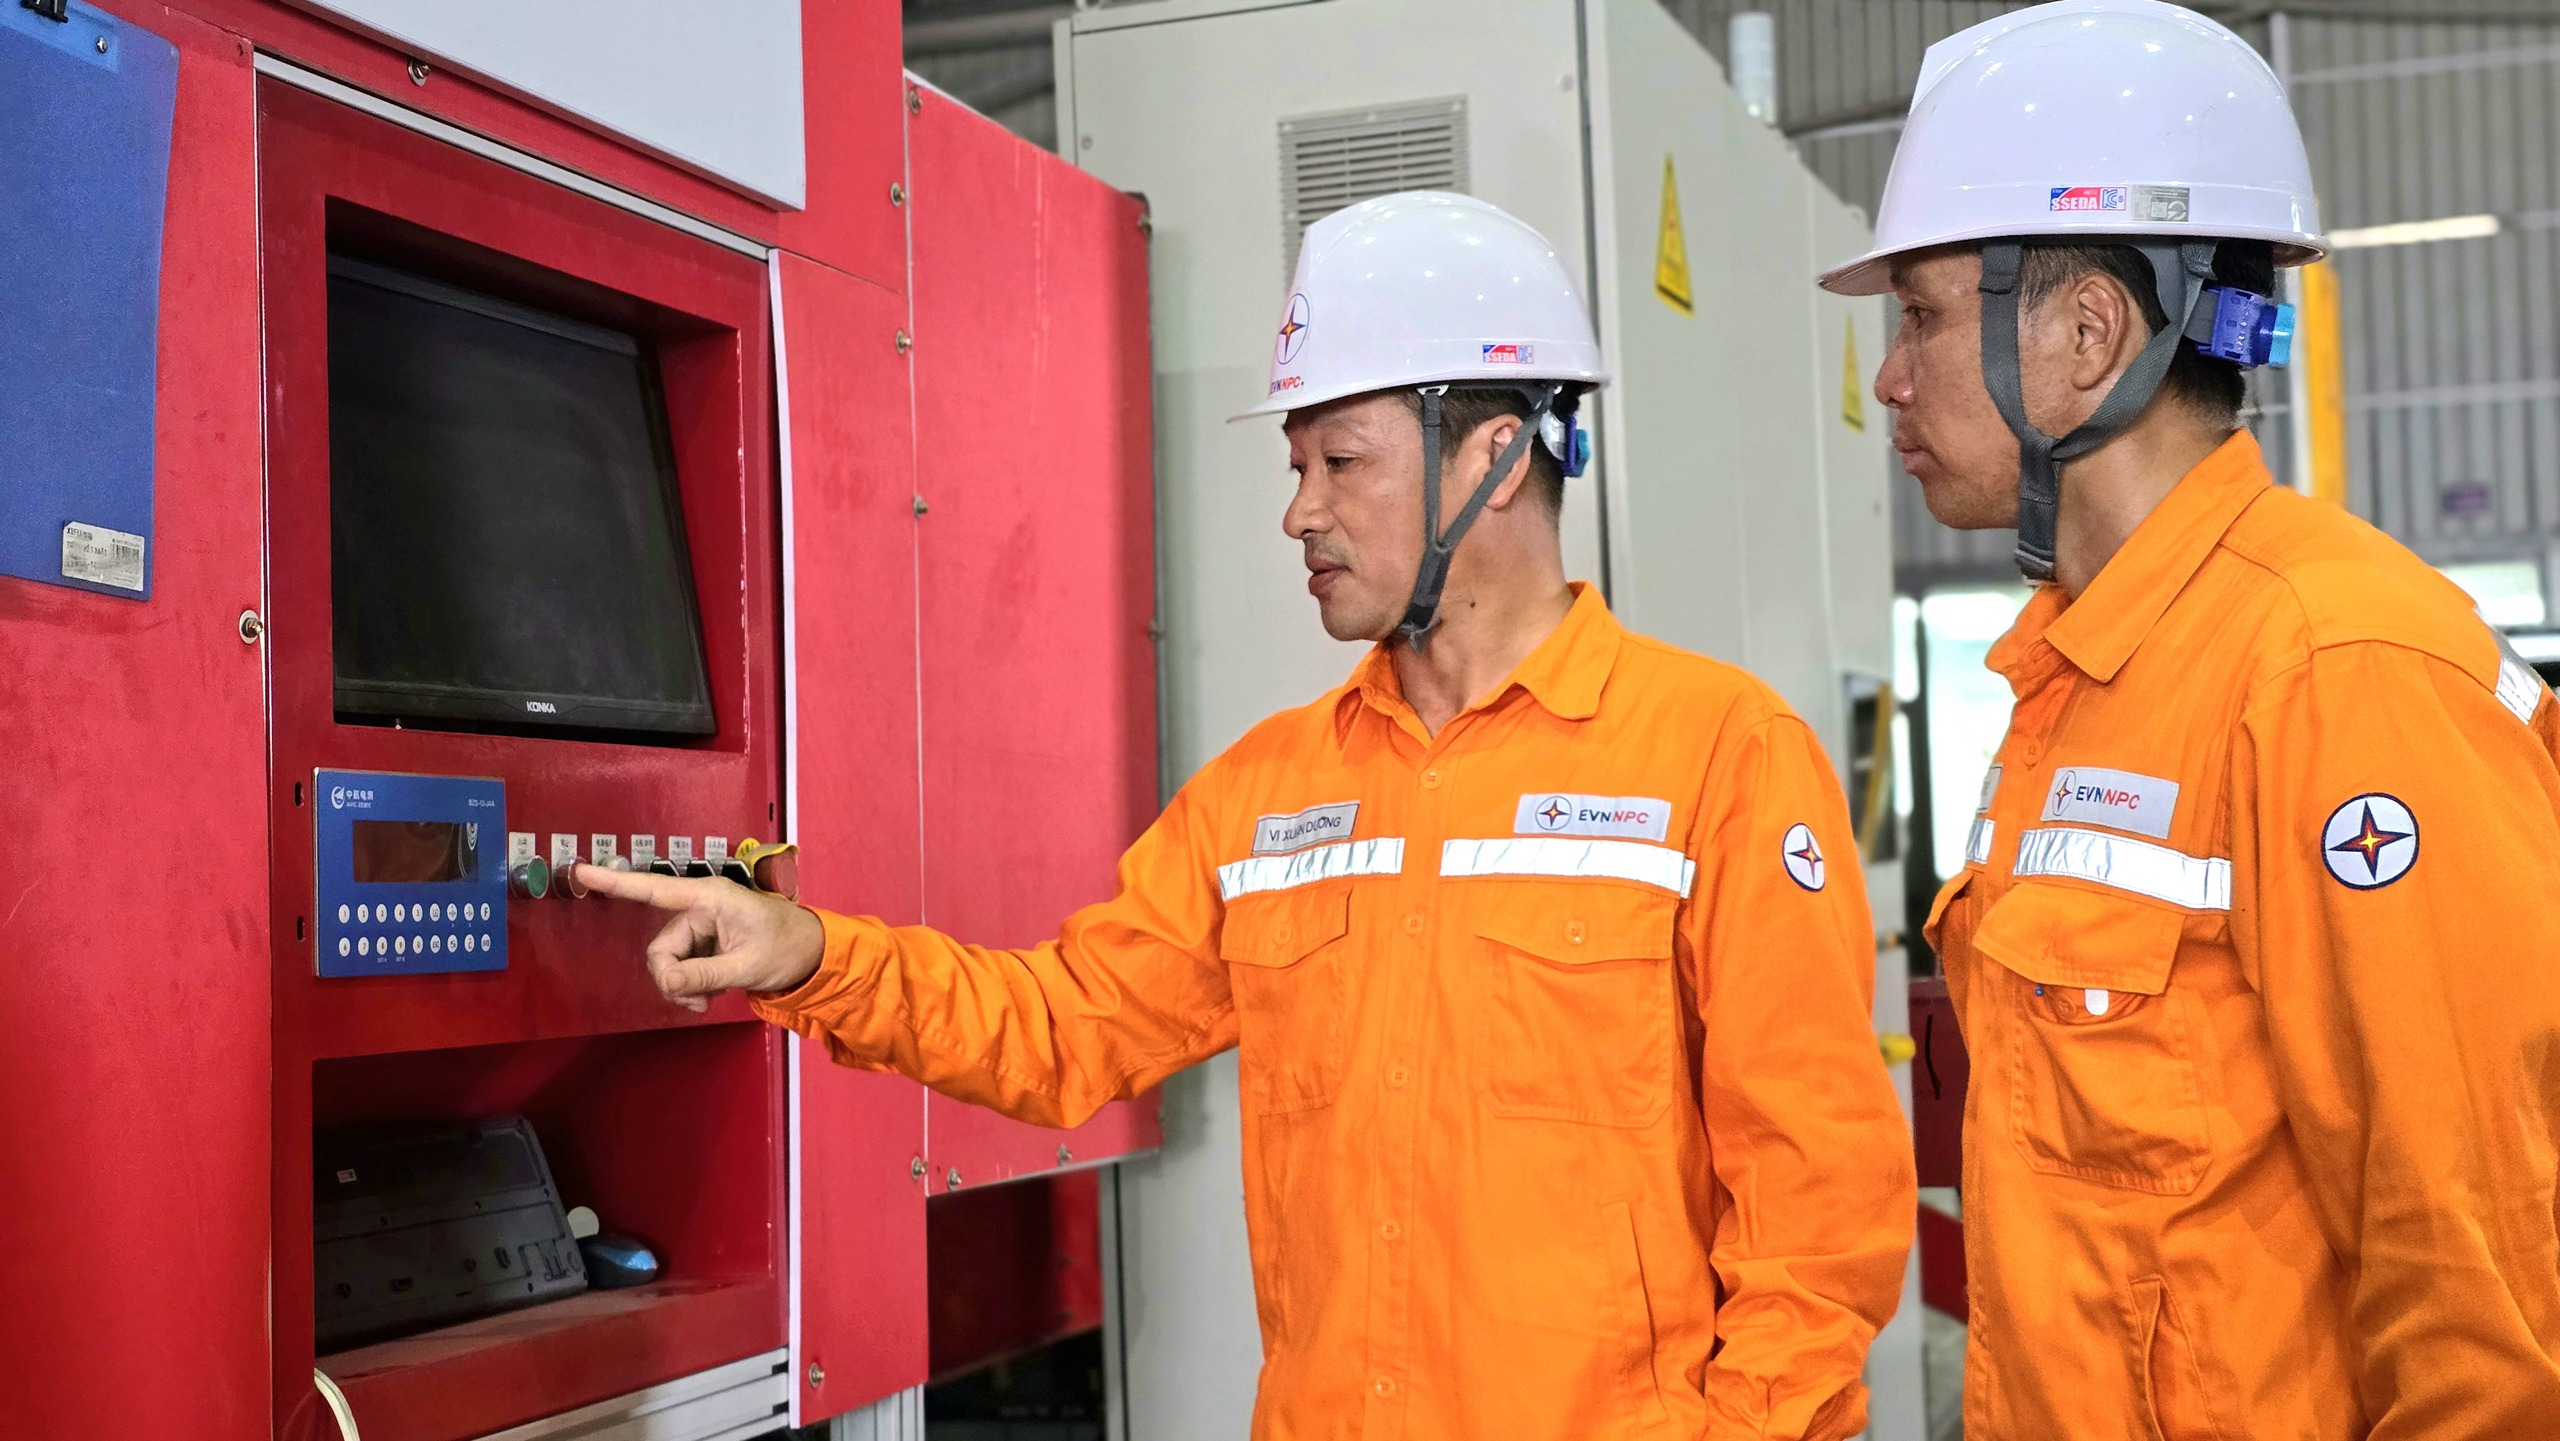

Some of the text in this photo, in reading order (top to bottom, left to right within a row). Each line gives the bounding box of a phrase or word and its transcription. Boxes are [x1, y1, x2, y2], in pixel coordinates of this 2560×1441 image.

[2051, 197, 2098, 210] SSEDA
[526, 701, 556, 714] KONKA
[2075, 785, 2141, 810] EVNNPC
[1578, 809, 1649, 824] EVNNPC
[1269, 829, 1280, 842] VI
